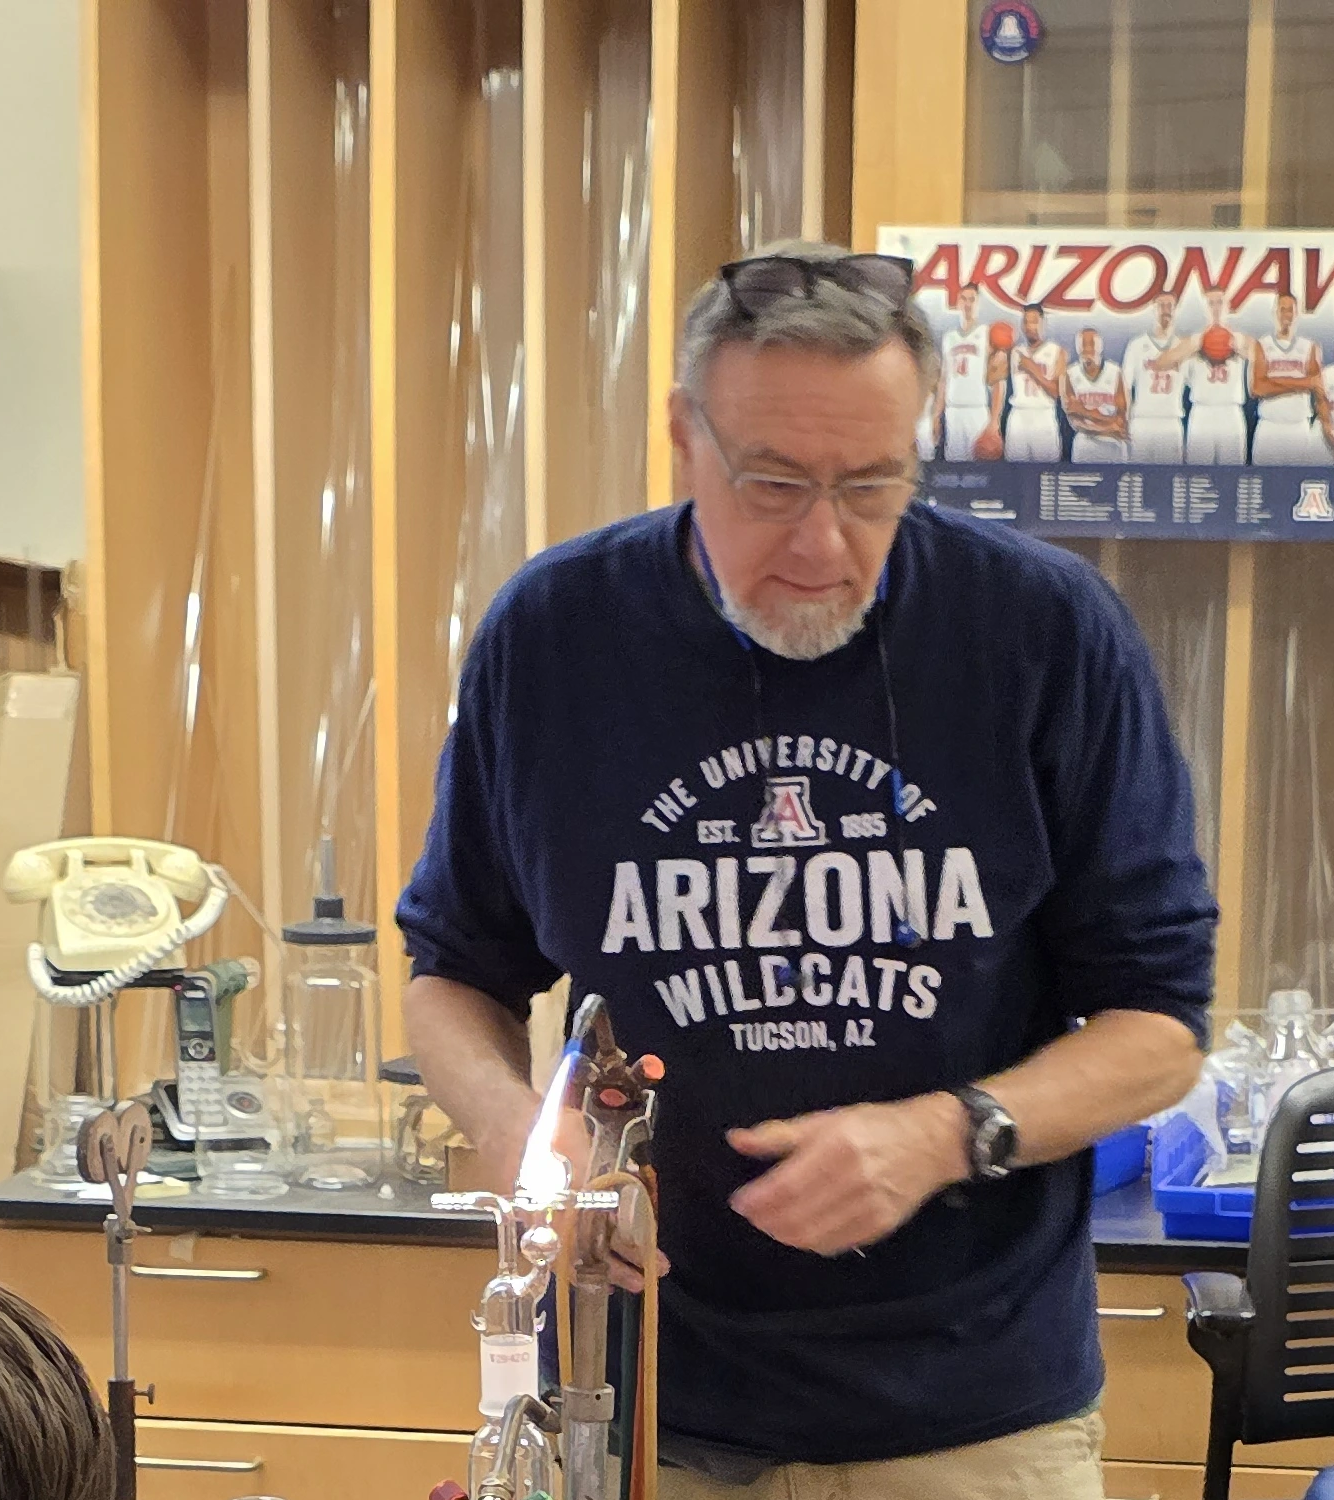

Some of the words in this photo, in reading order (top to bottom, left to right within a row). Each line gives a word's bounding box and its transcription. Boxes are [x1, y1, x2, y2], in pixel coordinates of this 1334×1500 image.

[641, 777, 698, 834] THE
[699, 735, 892, 791] UNIVERSITY
[897, 782, 939, 826] OF
[697, 819, 741, 844] EST.
[600, 847, 995, 955] ARIZONA
[654, 952, 944, 1029] WILDCATS
[728, 1022, 838, 1053] TUCSON,
[844, 1019, 877, 1048] AZ
